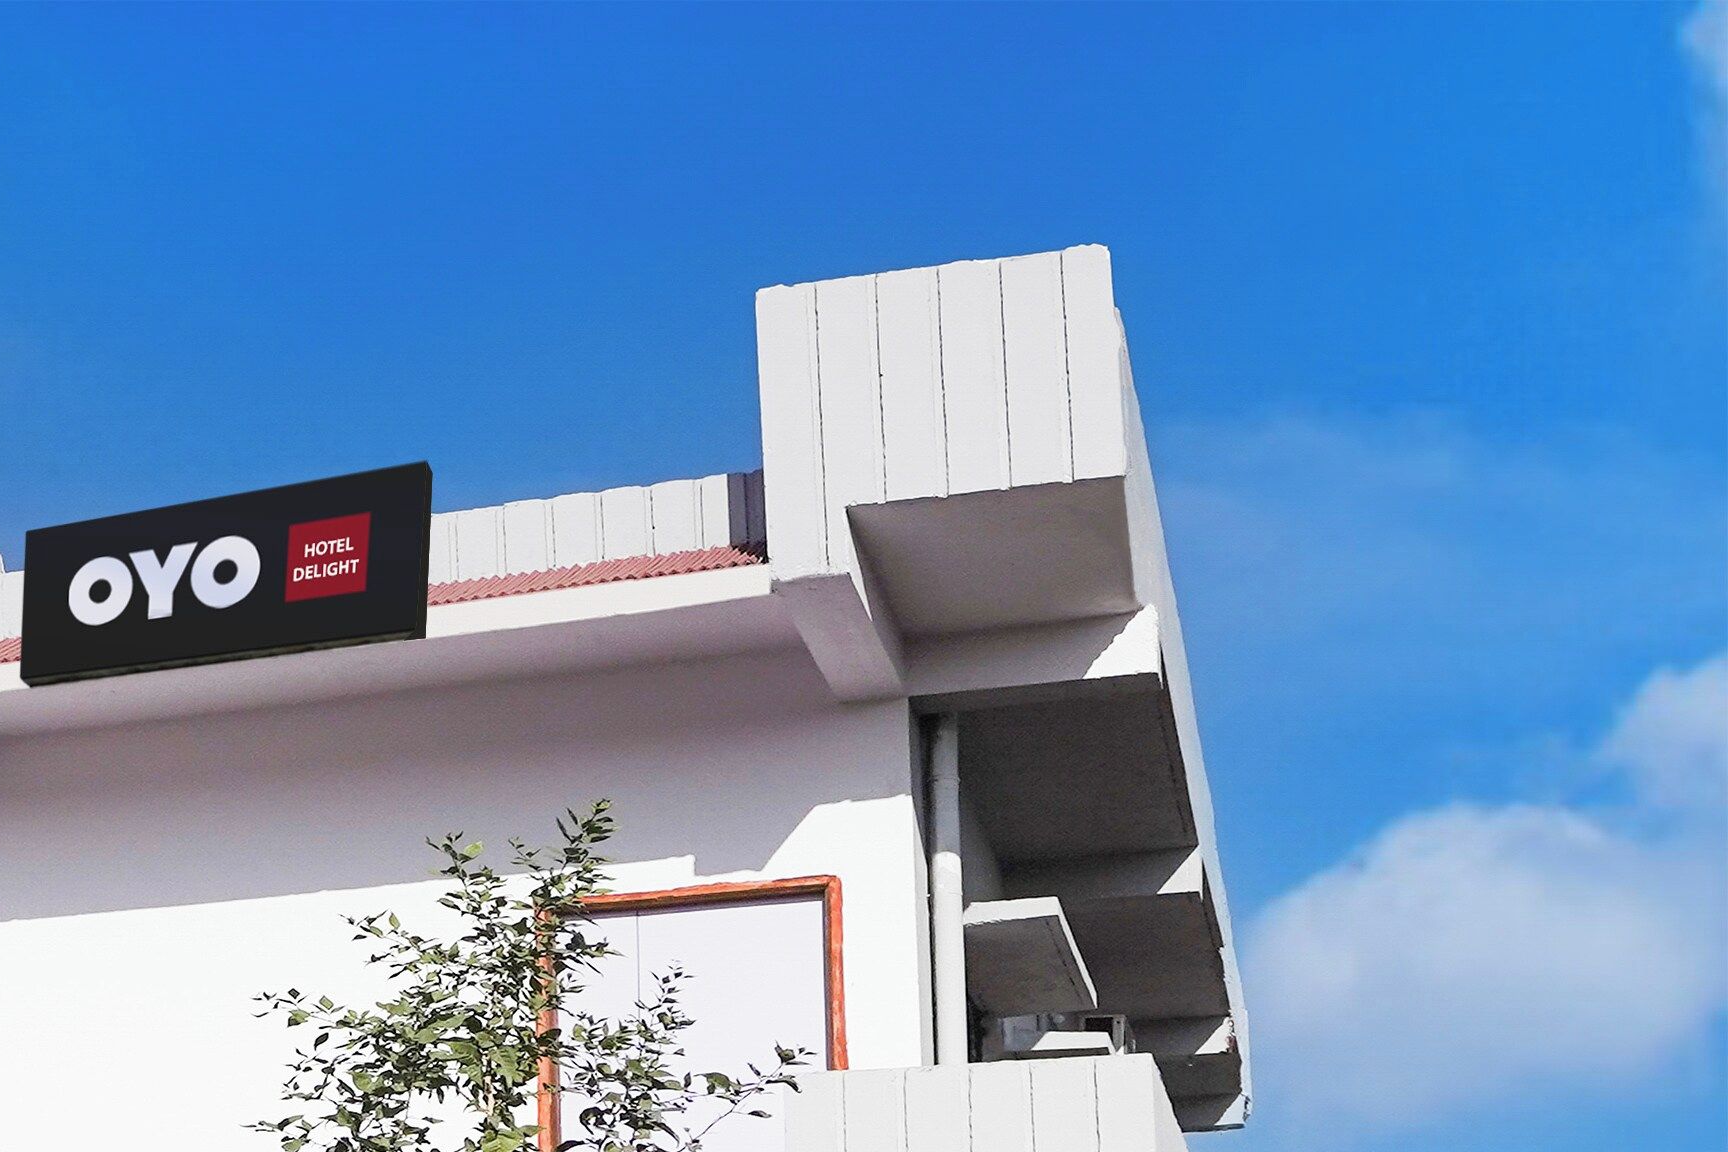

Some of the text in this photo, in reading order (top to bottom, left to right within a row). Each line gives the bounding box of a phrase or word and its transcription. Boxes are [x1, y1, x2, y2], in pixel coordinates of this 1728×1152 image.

[304, 537, 354, 558] HOTEL
[68, 535, 261, 627] OYO
[293, 558, 360, 582] DELIGHT
